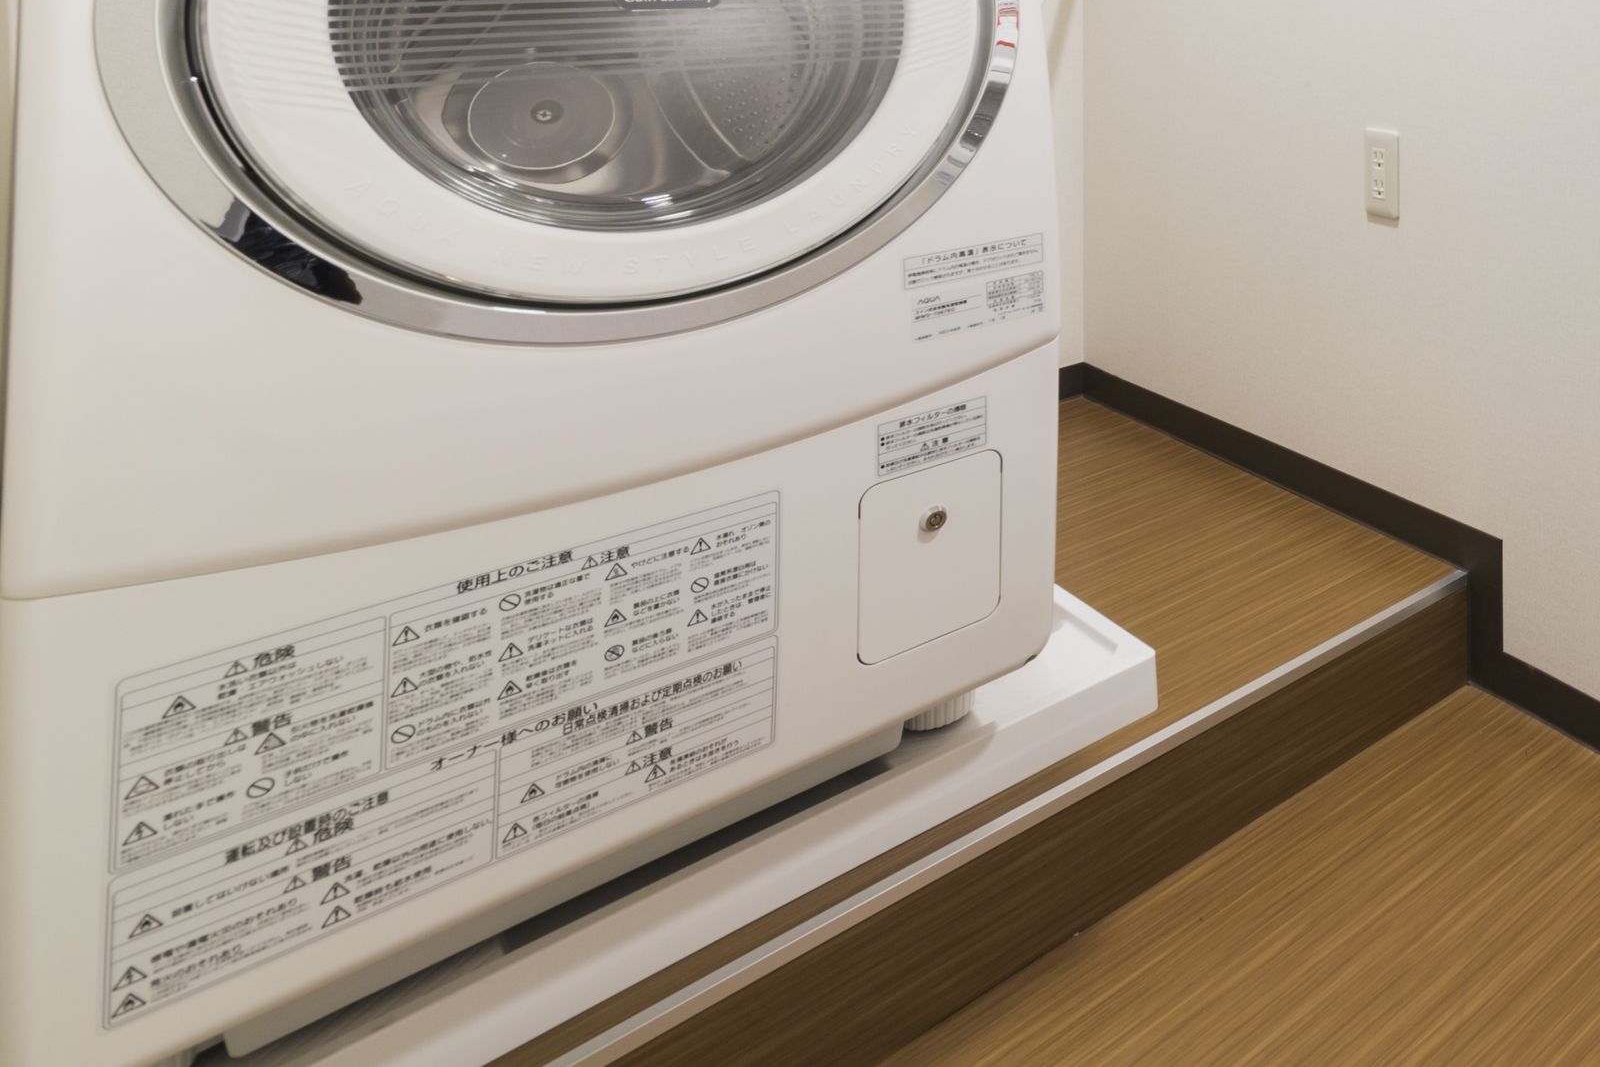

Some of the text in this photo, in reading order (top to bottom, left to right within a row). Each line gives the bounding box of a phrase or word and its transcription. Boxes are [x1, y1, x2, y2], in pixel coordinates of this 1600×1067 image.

[917, 295, 940, 305] AQUA
[600, 544, 630, 564] 注意
[457, 549, 573, 594] 使用上のご注意
[430, 699, 598, 772] オーナー様へのお願い
